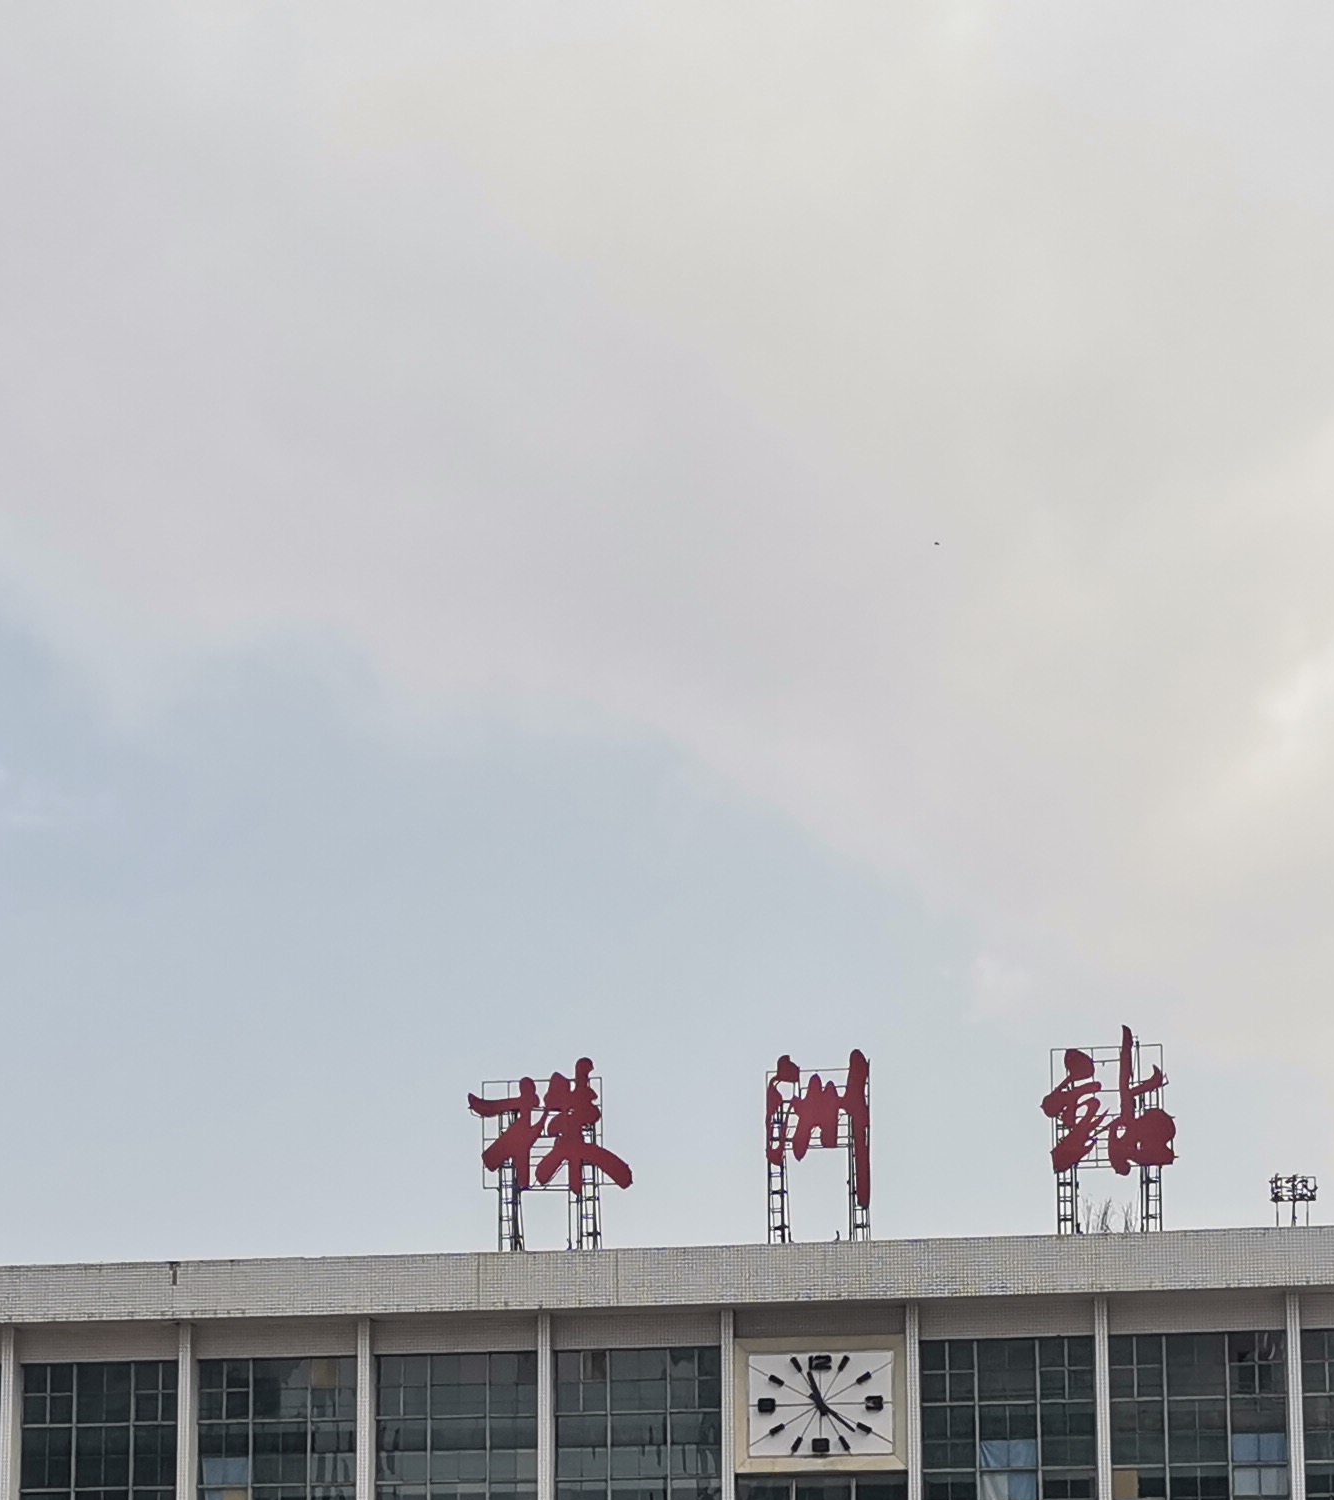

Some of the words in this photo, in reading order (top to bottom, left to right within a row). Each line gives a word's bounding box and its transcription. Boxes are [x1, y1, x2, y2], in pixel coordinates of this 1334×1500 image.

[468, 1025, 1177, 1208] 株洲站
[809, 1355, 832, 1371] 12
